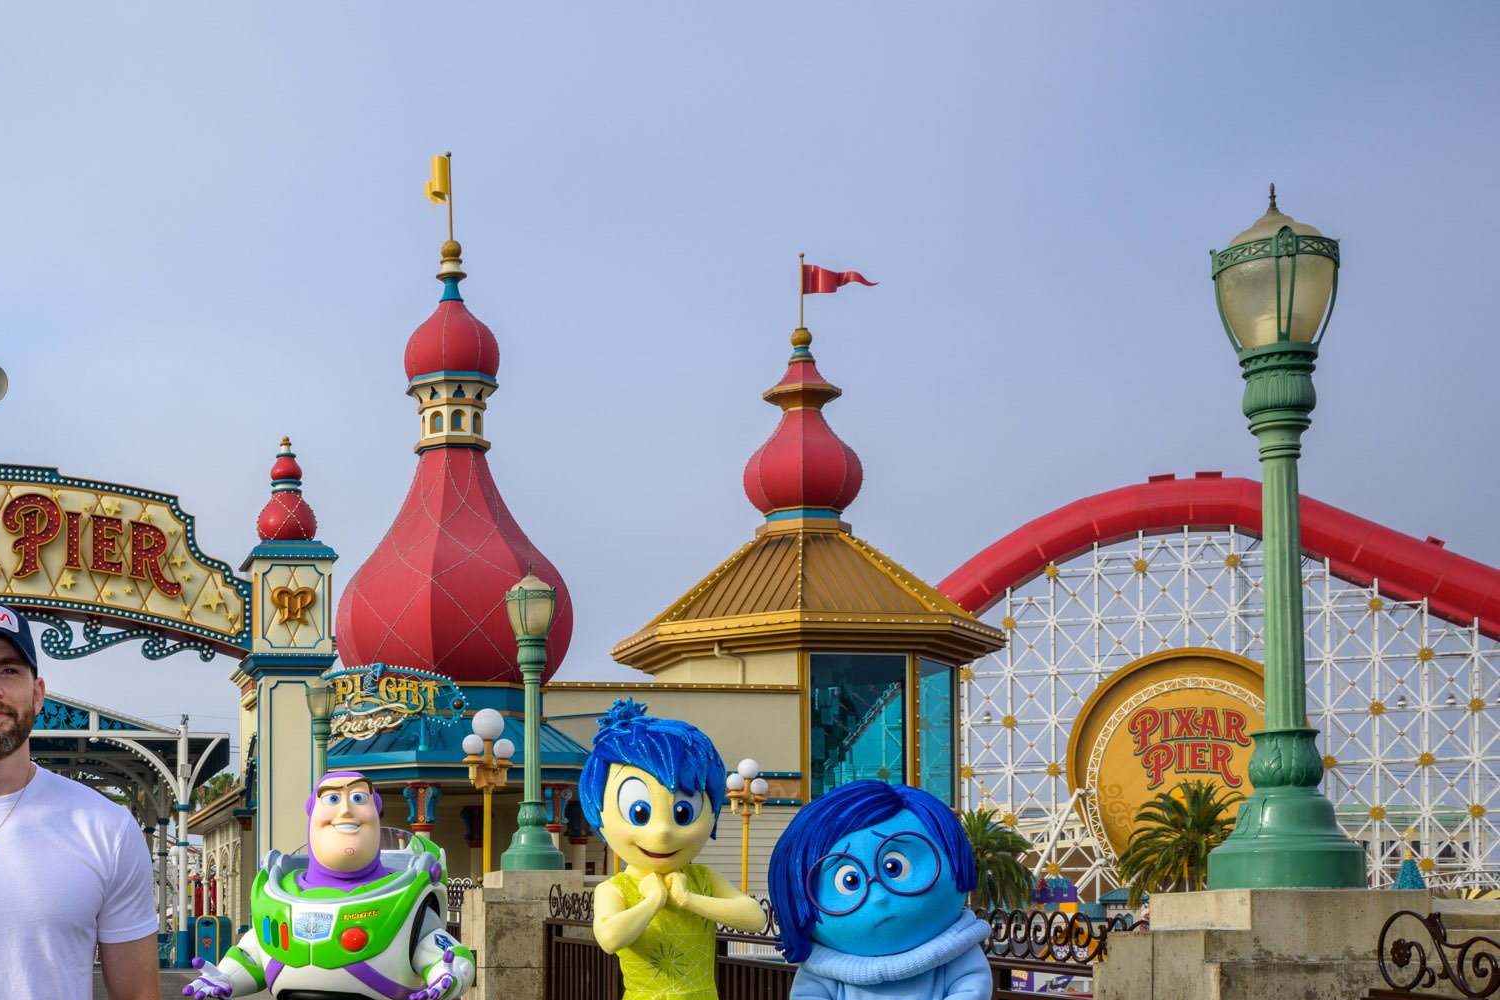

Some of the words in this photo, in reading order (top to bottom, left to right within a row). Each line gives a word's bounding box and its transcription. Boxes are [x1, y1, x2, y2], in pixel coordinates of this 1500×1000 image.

[2, 493, 182, 598] PIER
[1128, 706, 1253, 757] PIXAR
[1141, 740, 1243, 791] PIER
